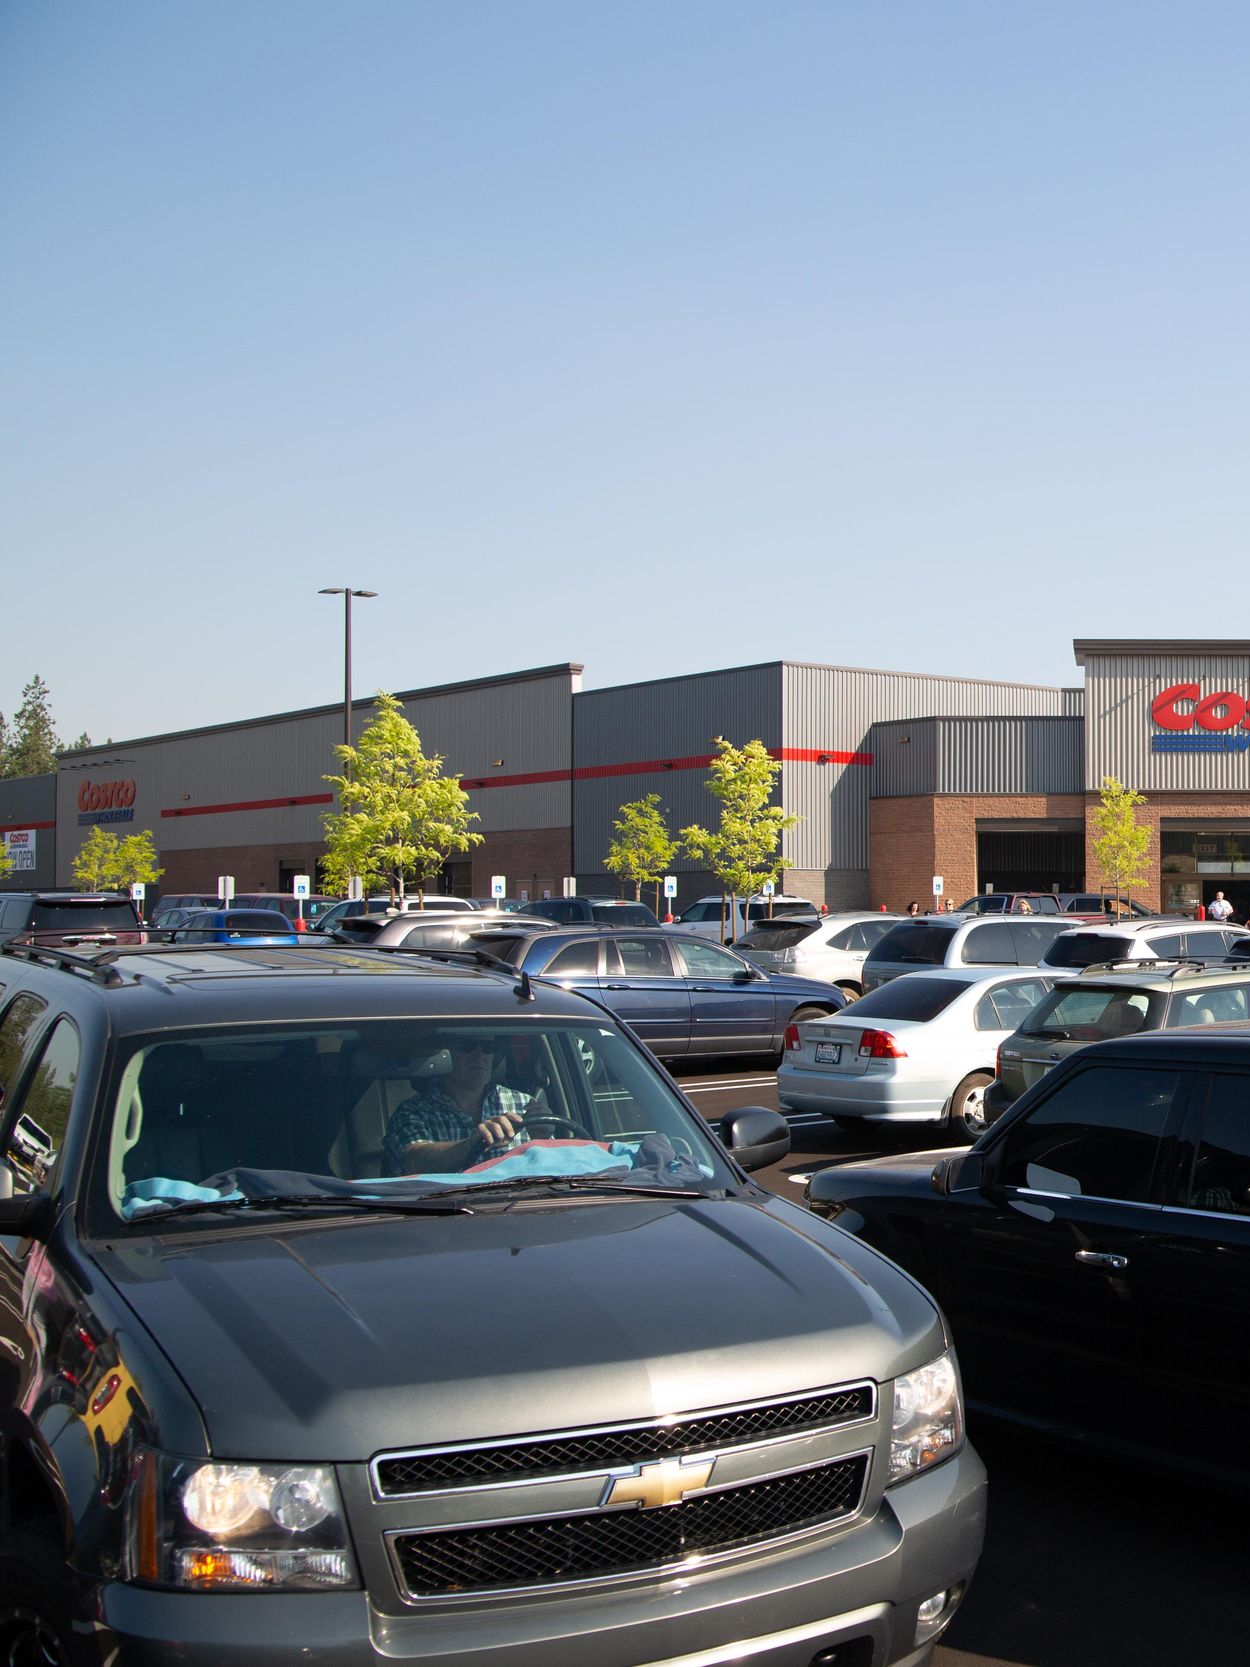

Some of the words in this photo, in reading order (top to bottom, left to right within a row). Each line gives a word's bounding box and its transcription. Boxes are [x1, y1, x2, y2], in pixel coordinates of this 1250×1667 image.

[77, 779, 136, 812] COSTCO
[10, 833, 29, 844] COSTCO
[18, 850, 35, 869] OPEN
